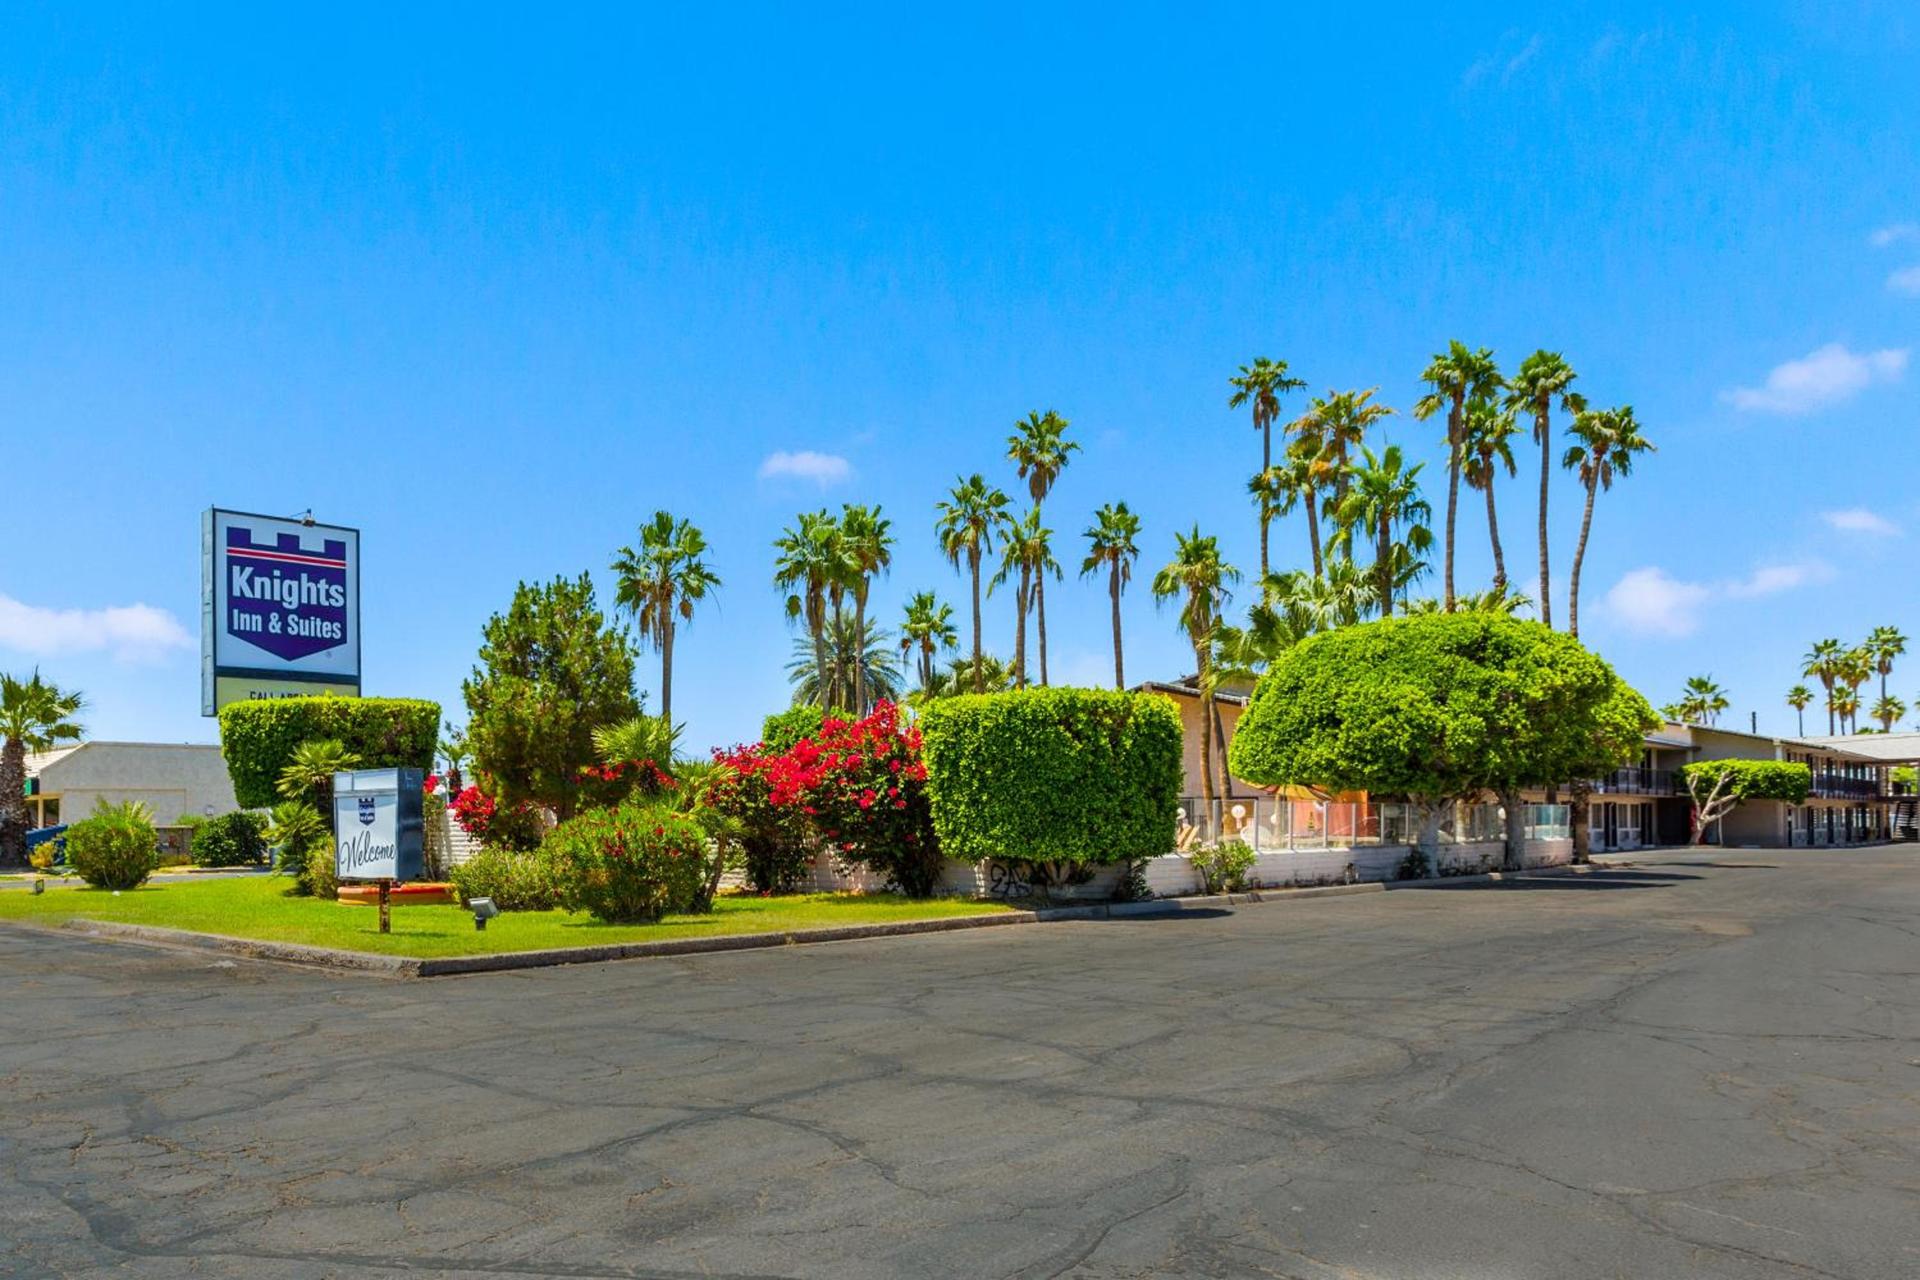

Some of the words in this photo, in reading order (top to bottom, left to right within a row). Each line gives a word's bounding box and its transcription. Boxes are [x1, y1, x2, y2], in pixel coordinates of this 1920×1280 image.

[232, 565, 344, 610] Knights
[232, 609, 262, 632] Inn
[268, 612, 282, 635] &
[287, 614, 342, 640] Suites
[340, 830, 396, 872] Welcome
